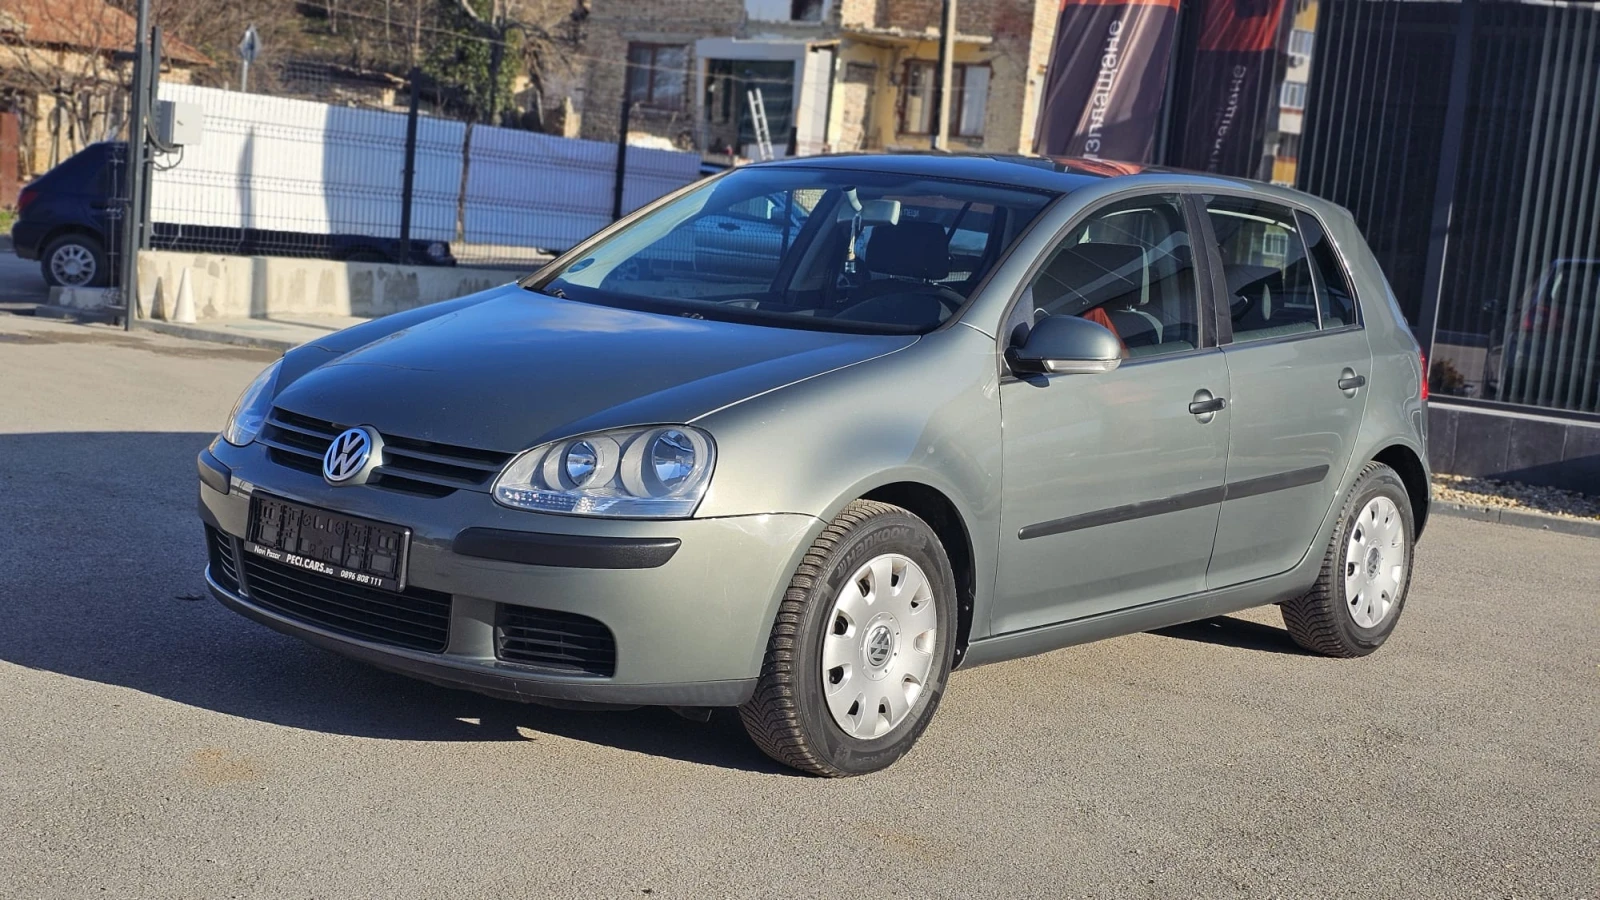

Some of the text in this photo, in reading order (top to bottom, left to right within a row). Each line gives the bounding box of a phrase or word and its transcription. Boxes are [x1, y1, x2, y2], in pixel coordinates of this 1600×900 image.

[254, 545, 266, 556] Novi
[340, 569, 356, 581] 0896
[370, 574, 383, 587] 111
